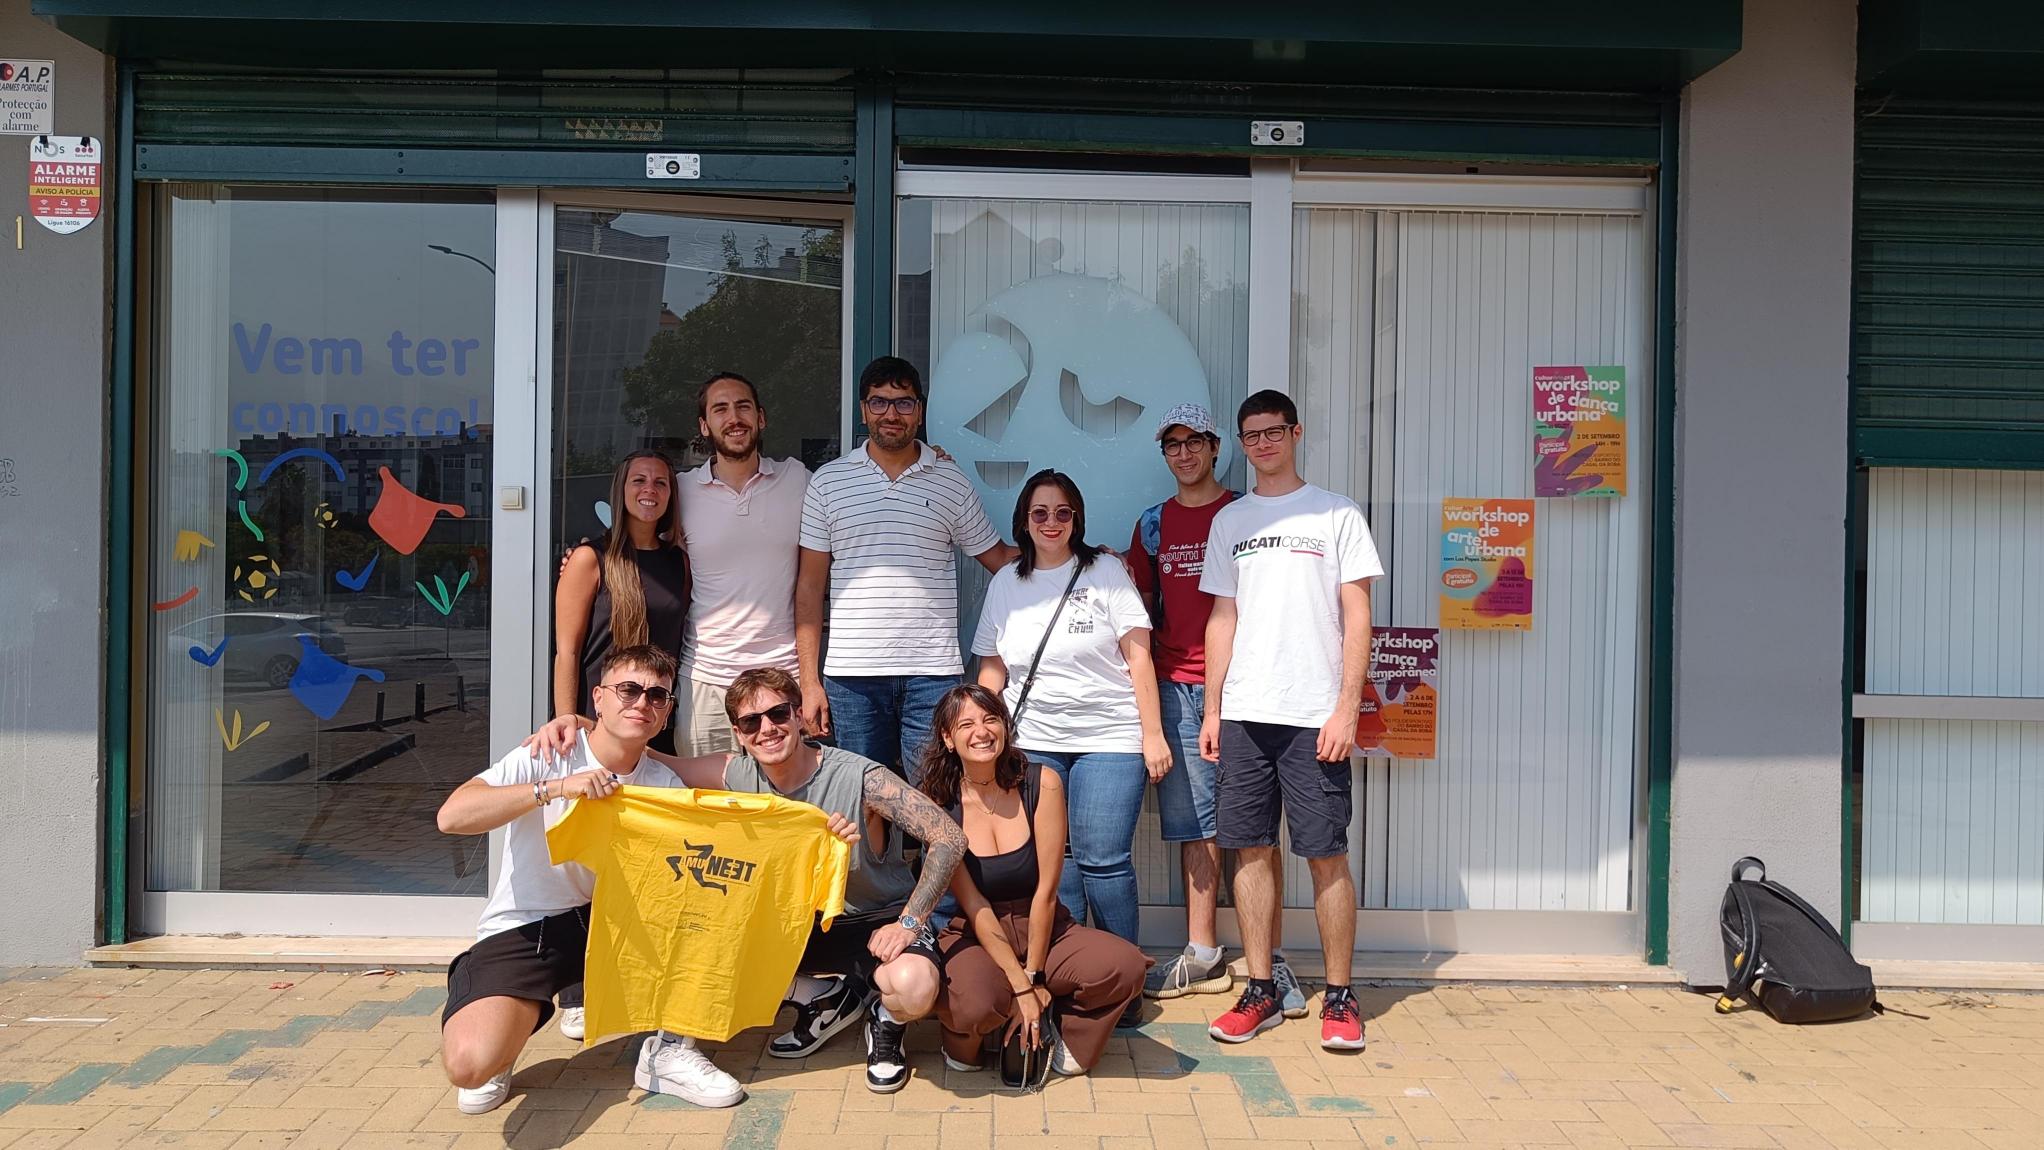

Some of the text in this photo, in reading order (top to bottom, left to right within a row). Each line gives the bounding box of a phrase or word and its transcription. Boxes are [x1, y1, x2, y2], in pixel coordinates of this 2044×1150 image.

[14, 66, 50, 84] A.P.
[0, 83, 48, 92] LARMES PORTUGAL
[9, 111, 32, 119] com
[2, 119, 39, 131] alarme
[34, 164, 96, 177] ALARME
[34, 176, 96, 185] INTELIGENTE
[66, 188, 94, 196] POLÍCIA
[232, 322, 480, 377] Vem ter
[1535, 374, 1621, 395] workshop
[1547, 391, 1619, 415] de dança
[231, 398, 479, 440] connosco!
[1536, 405, 1600, 421] urbana
[1444, 506, 1529, 527] workshop
[1478, 521, 1499, 537] de
[1232, 536, 1326, 556] DUCATI CORSE
[1447, 532, 1482, 546] arte
[1464, 540, 1526, 556] urbana
[1159, 550, 1199, 563] SOUTH
[1371, 632, 1434, 653] orkshop
[1367, 667, 1436, 681] temporânea
